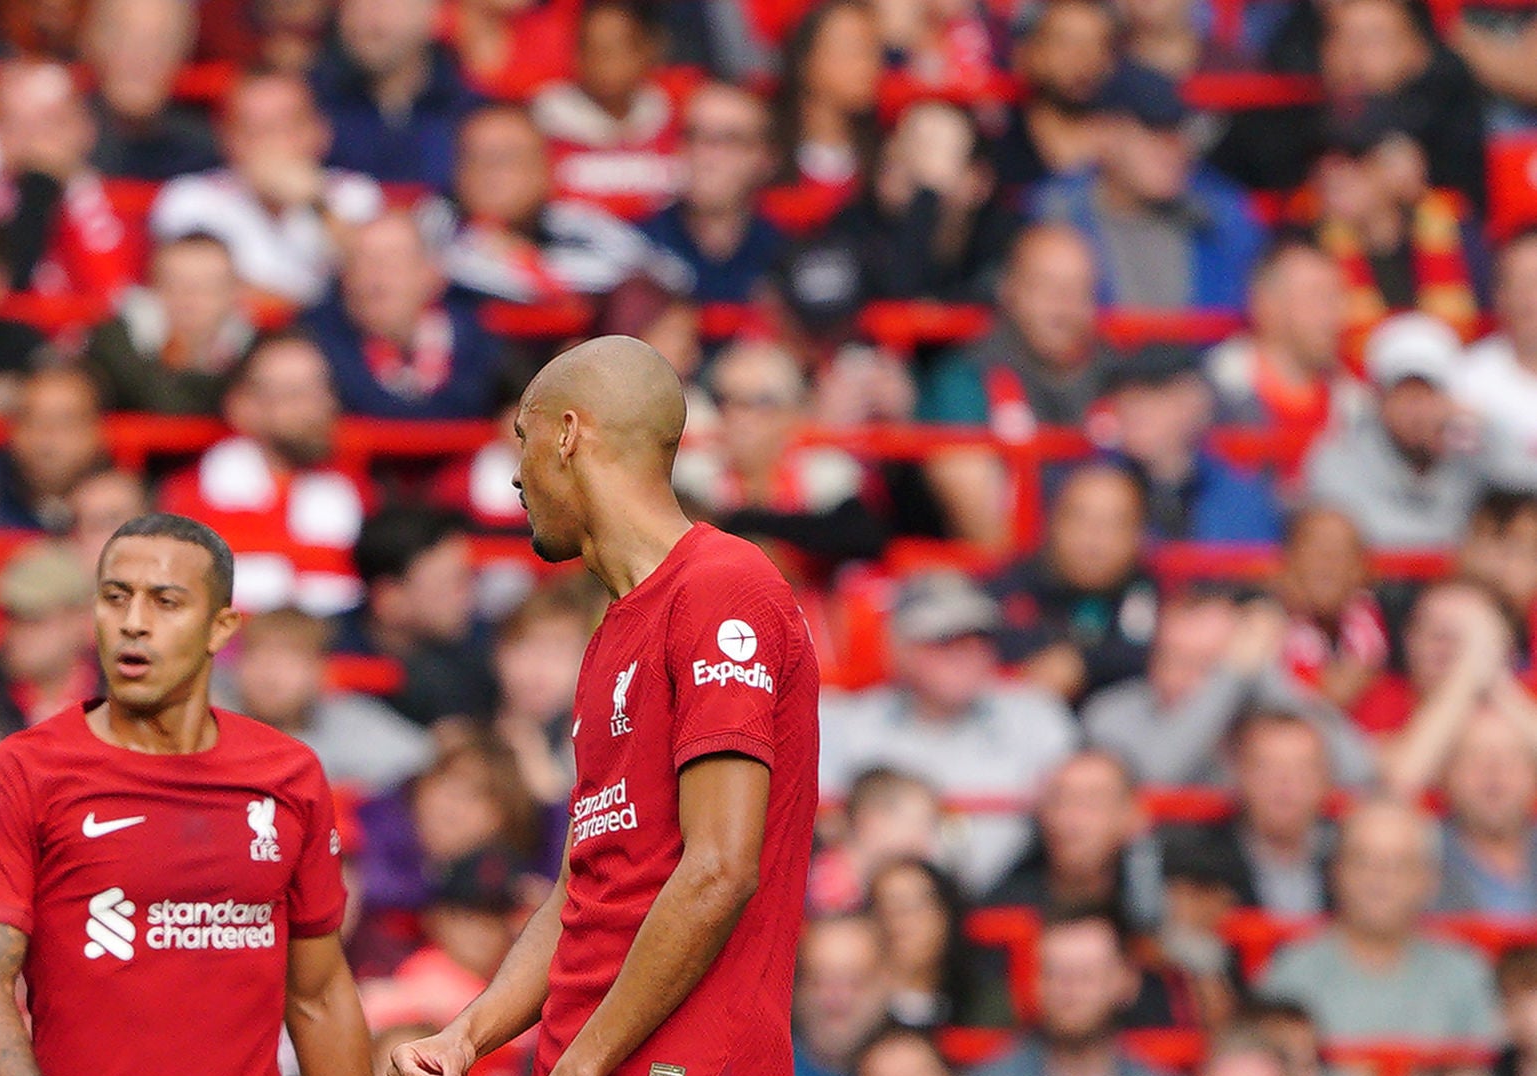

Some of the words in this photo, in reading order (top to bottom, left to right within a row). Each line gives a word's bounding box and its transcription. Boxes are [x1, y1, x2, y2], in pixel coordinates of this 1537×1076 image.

[692, 659, 774, 694] Expedia
[573, 777, 627, 822] standard
[147, 899, 274, 926] standard
[145, 922, 276, 950] chartered
